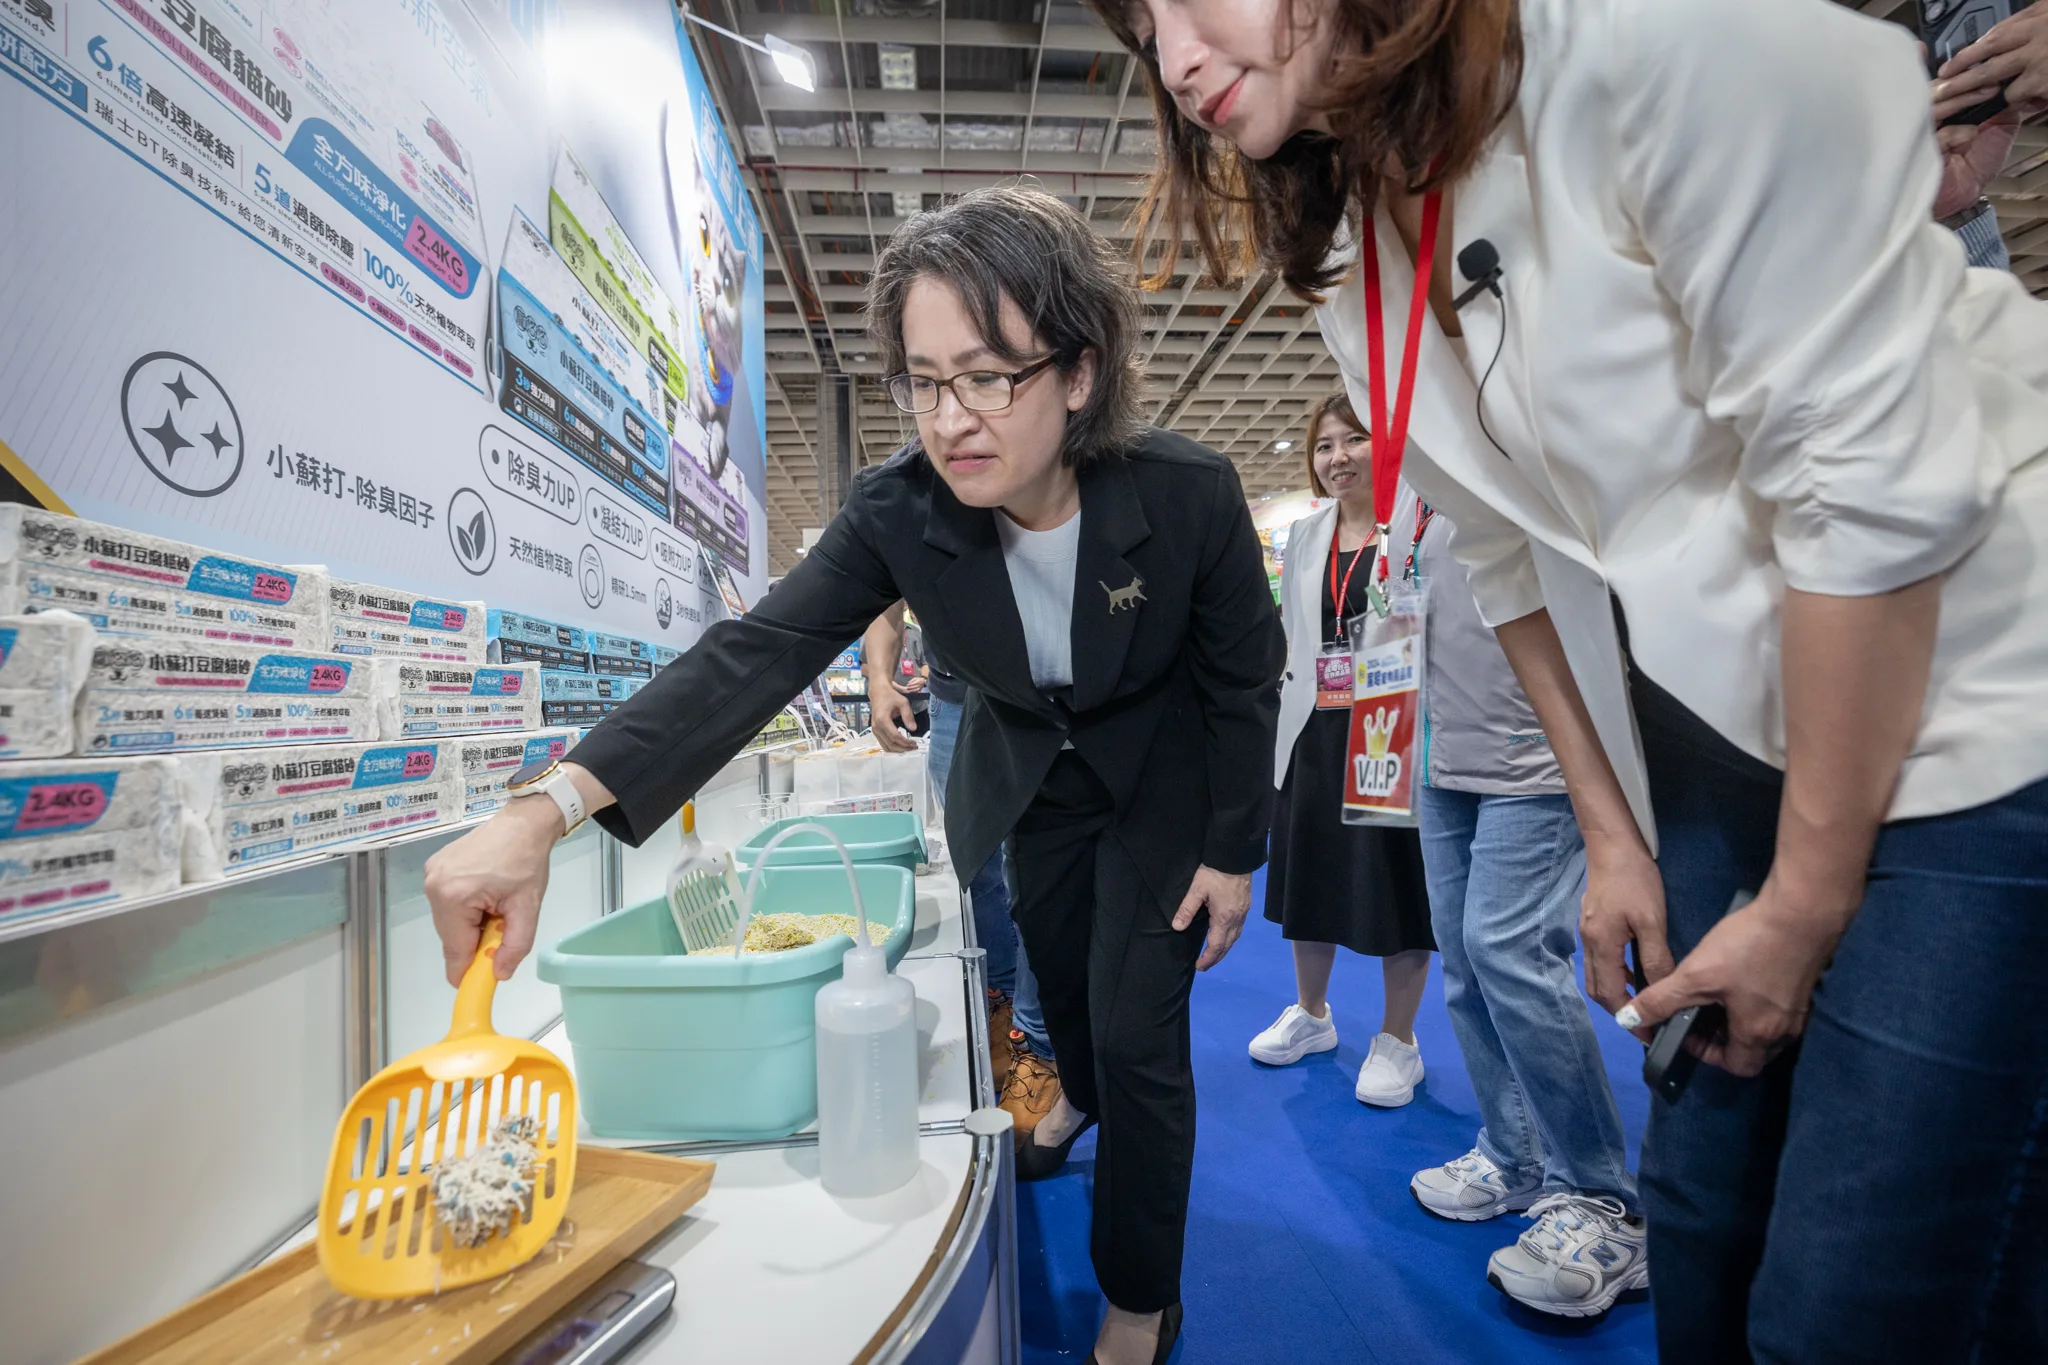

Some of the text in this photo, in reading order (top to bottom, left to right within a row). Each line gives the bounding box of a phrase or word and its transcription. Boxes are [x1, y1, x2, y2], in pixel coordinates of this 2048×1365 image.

[0, 0, 45, 37] econds
[117, 0, 208, 78] ONTROLLING
[208, 65, 230, 96] CAT
[231, 92, 270, 128] LITTER
[87, 34, 236, 170] 6倍高速凝結
[106, 77, 134, 104] times
[136, 100, 163, 126] faster
[166, 124, 224, 170] condensation
[312, 132, 407, 231] 全方味淨化
[254, 161, 355, 261] 5道過篩除塵
[416, 223, 464, 279] 2.4KG
[266, 443, 436, 529] 小蘇打-除臭因子
[507, 449, 576, 510] 除臭力UP
[600, 505, 645, 549] 凝結力UP
[256, 576, 287, 592] 2.4KG
[509, 536, 574, 579] 天然植物萃取
[313, 668, 342, 682] 2.4KG
[406, 754, 431, 768] 2.4KG
